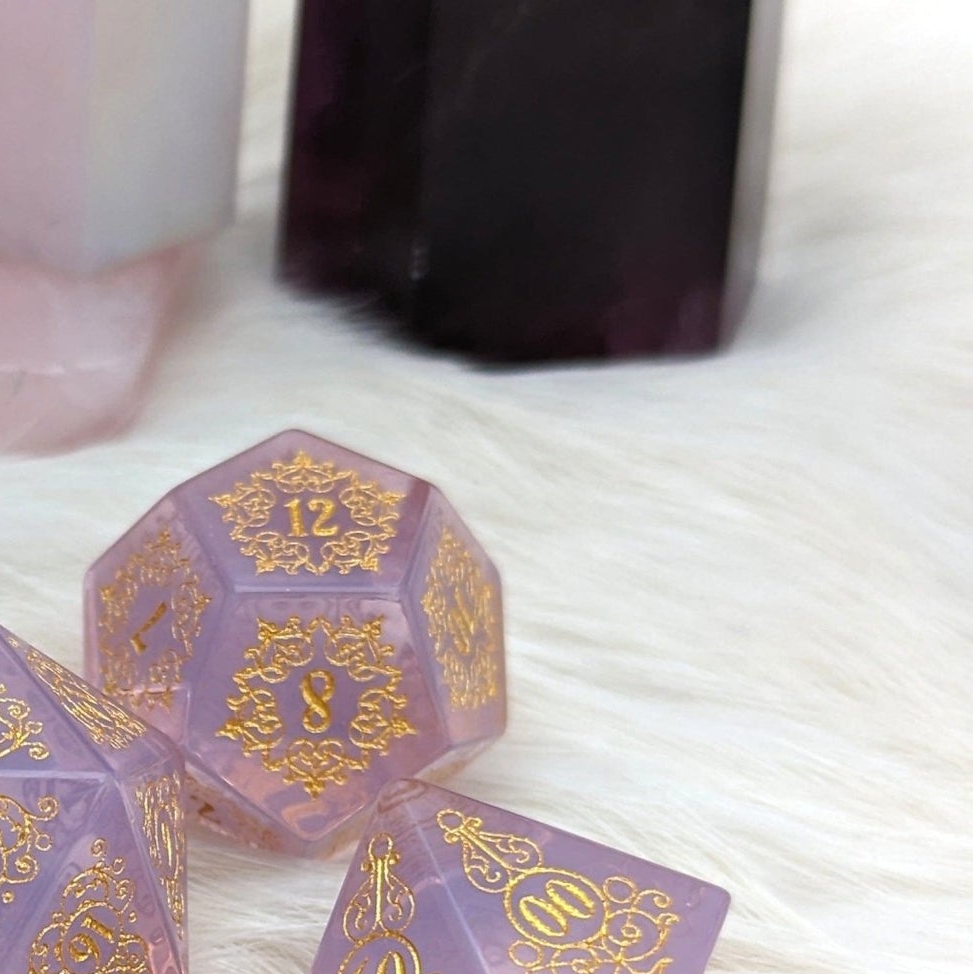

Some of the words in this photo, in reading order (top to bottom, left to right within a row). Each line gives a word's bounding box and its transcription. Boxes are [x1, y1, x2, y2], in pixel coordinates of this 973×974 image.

[283, 498, 339, 538] 12
[299, 669, 335, 734] 8
[519, 878, 595, 938] 00
